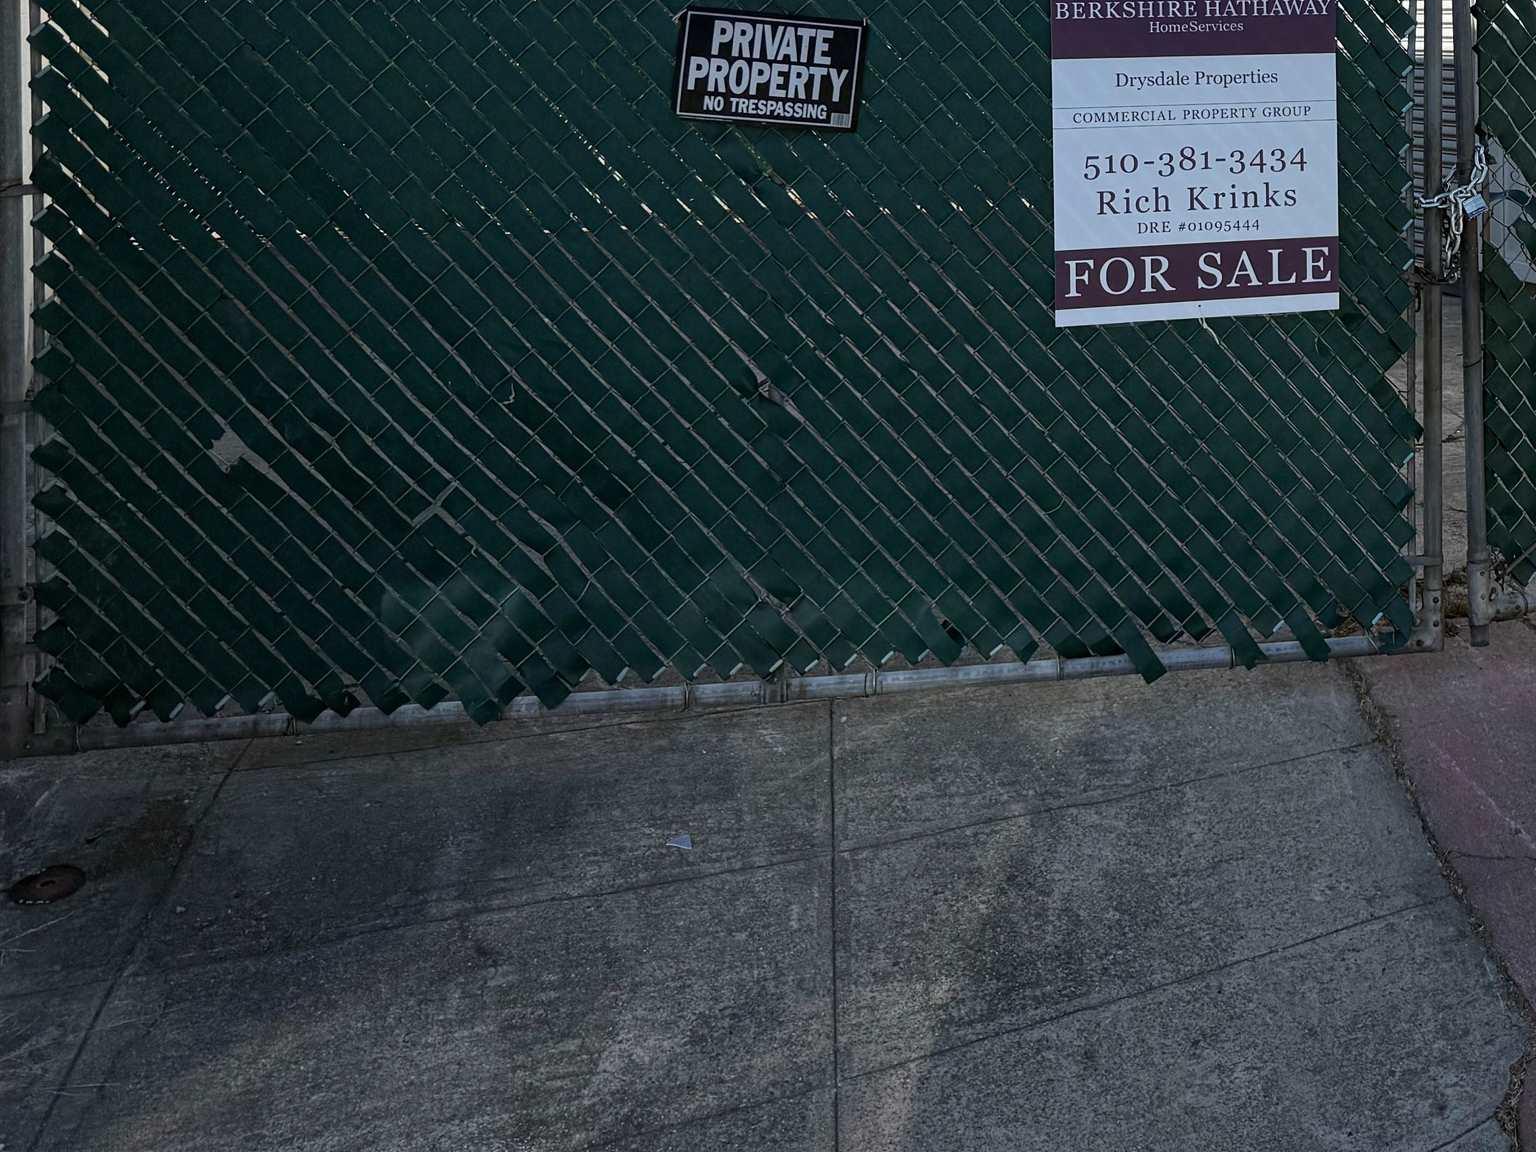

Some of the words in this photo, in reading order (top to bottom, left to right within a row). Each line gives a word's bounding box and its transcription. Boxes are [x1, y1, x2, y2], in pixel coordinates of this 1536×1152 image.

[1055, 0, 1197, 20] BERKSHIRE
[1149, 20, 1244, 33] HomeServices
[711, 19, 835, 65] PRIVATE
[687, 55, 849, 102] PROPERTY
[1115, 70, 1189, 90] Drysdale
[1195, 69, 1278, 88] Properties
[703, 95, 724, 111] NO
[730, 98, 827, 120] TRESPASSING
[1072, 110, 1176, 124] COMMERCIAL
[1183, 107, 1257, 120] PROPERTY
[1262, 106, 1311, 118] GROUP
[1083, 146, 1308, 180] 510-381-3434
[1096, 186, 1172, 216] Rich
[1187, 182, 1297, 211] Krinks
[1137, 221, 1171, 234] DRE
[1178, 219, 1260, 232] #01095444
[1064, 255, 1176, 298] FOR
[1197, 246, 1332, 290] SALE
